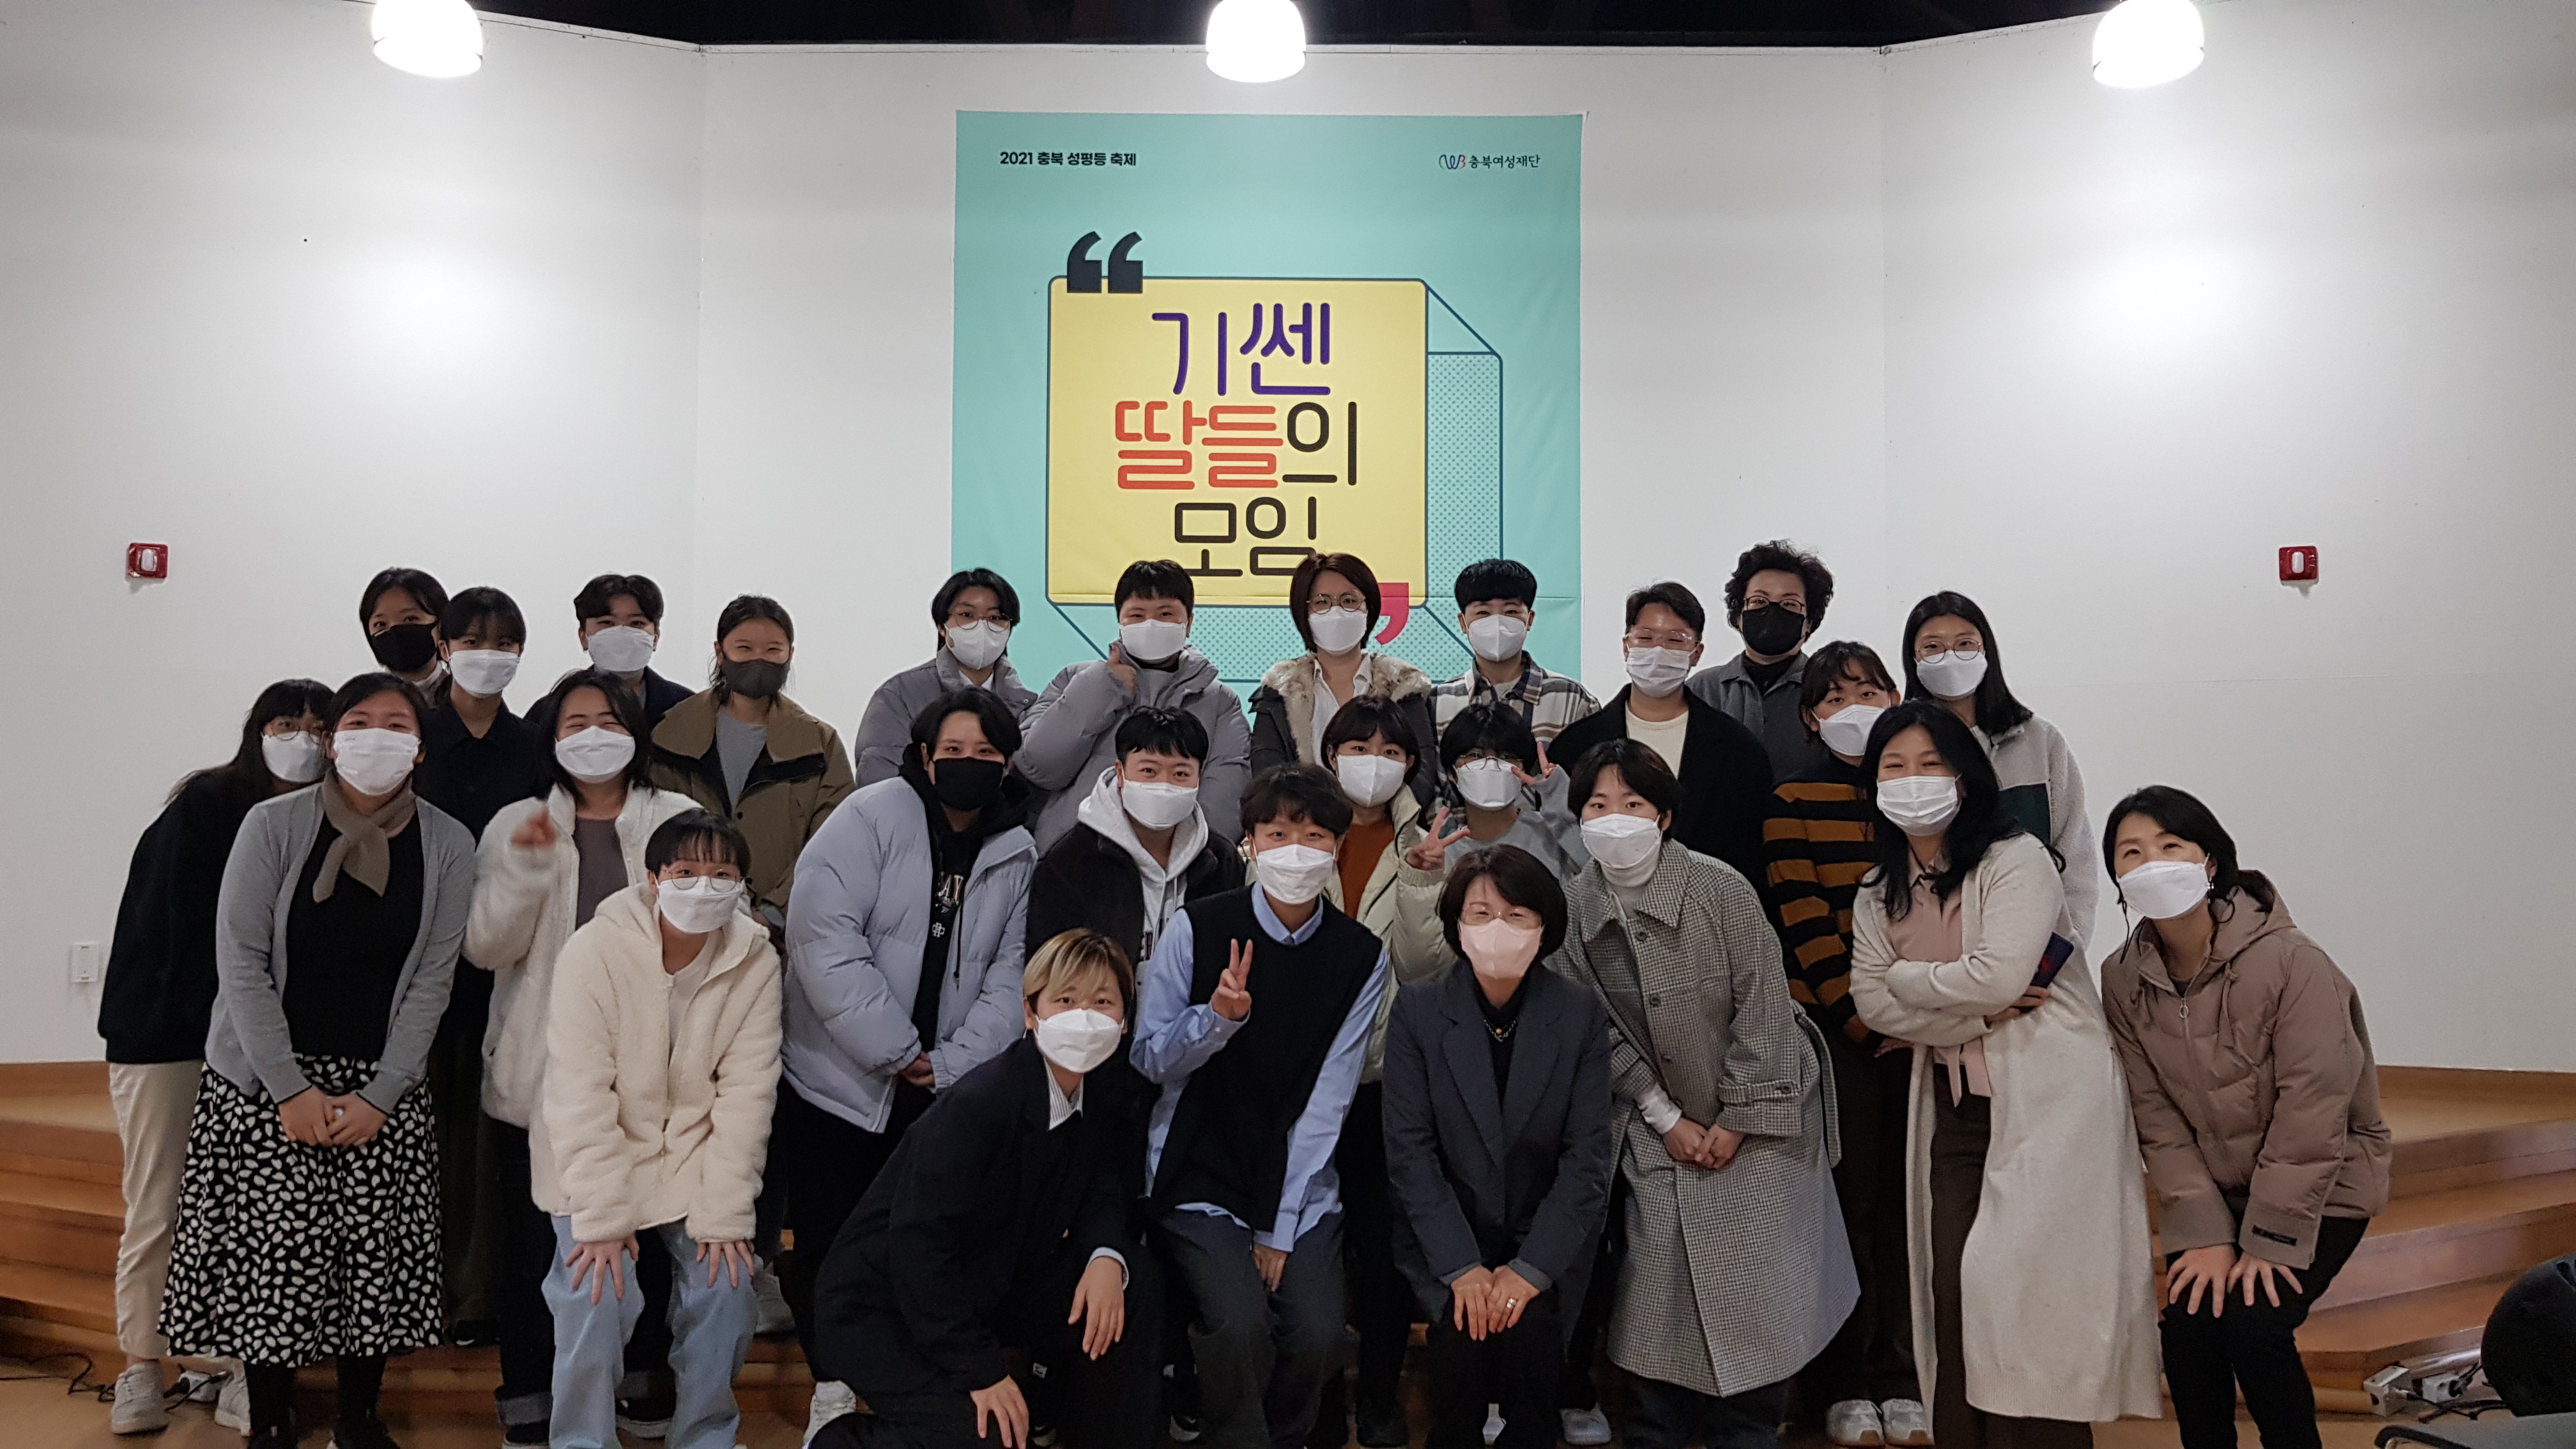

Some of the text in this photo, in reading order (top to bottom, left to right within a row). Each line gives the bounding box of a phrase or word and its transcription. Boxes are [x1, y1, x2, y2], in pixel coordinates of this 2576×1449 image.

[1000, 151, 1137, 166] 2021 충북 성평등 축제
[1468, 155, 1541, 169] 충북여성재단
[1152, 303, 1330, 396] 기쎈
[1115, 401, 1357, 490] 딸들의
[1174, 496, 1317, 577] 모임
